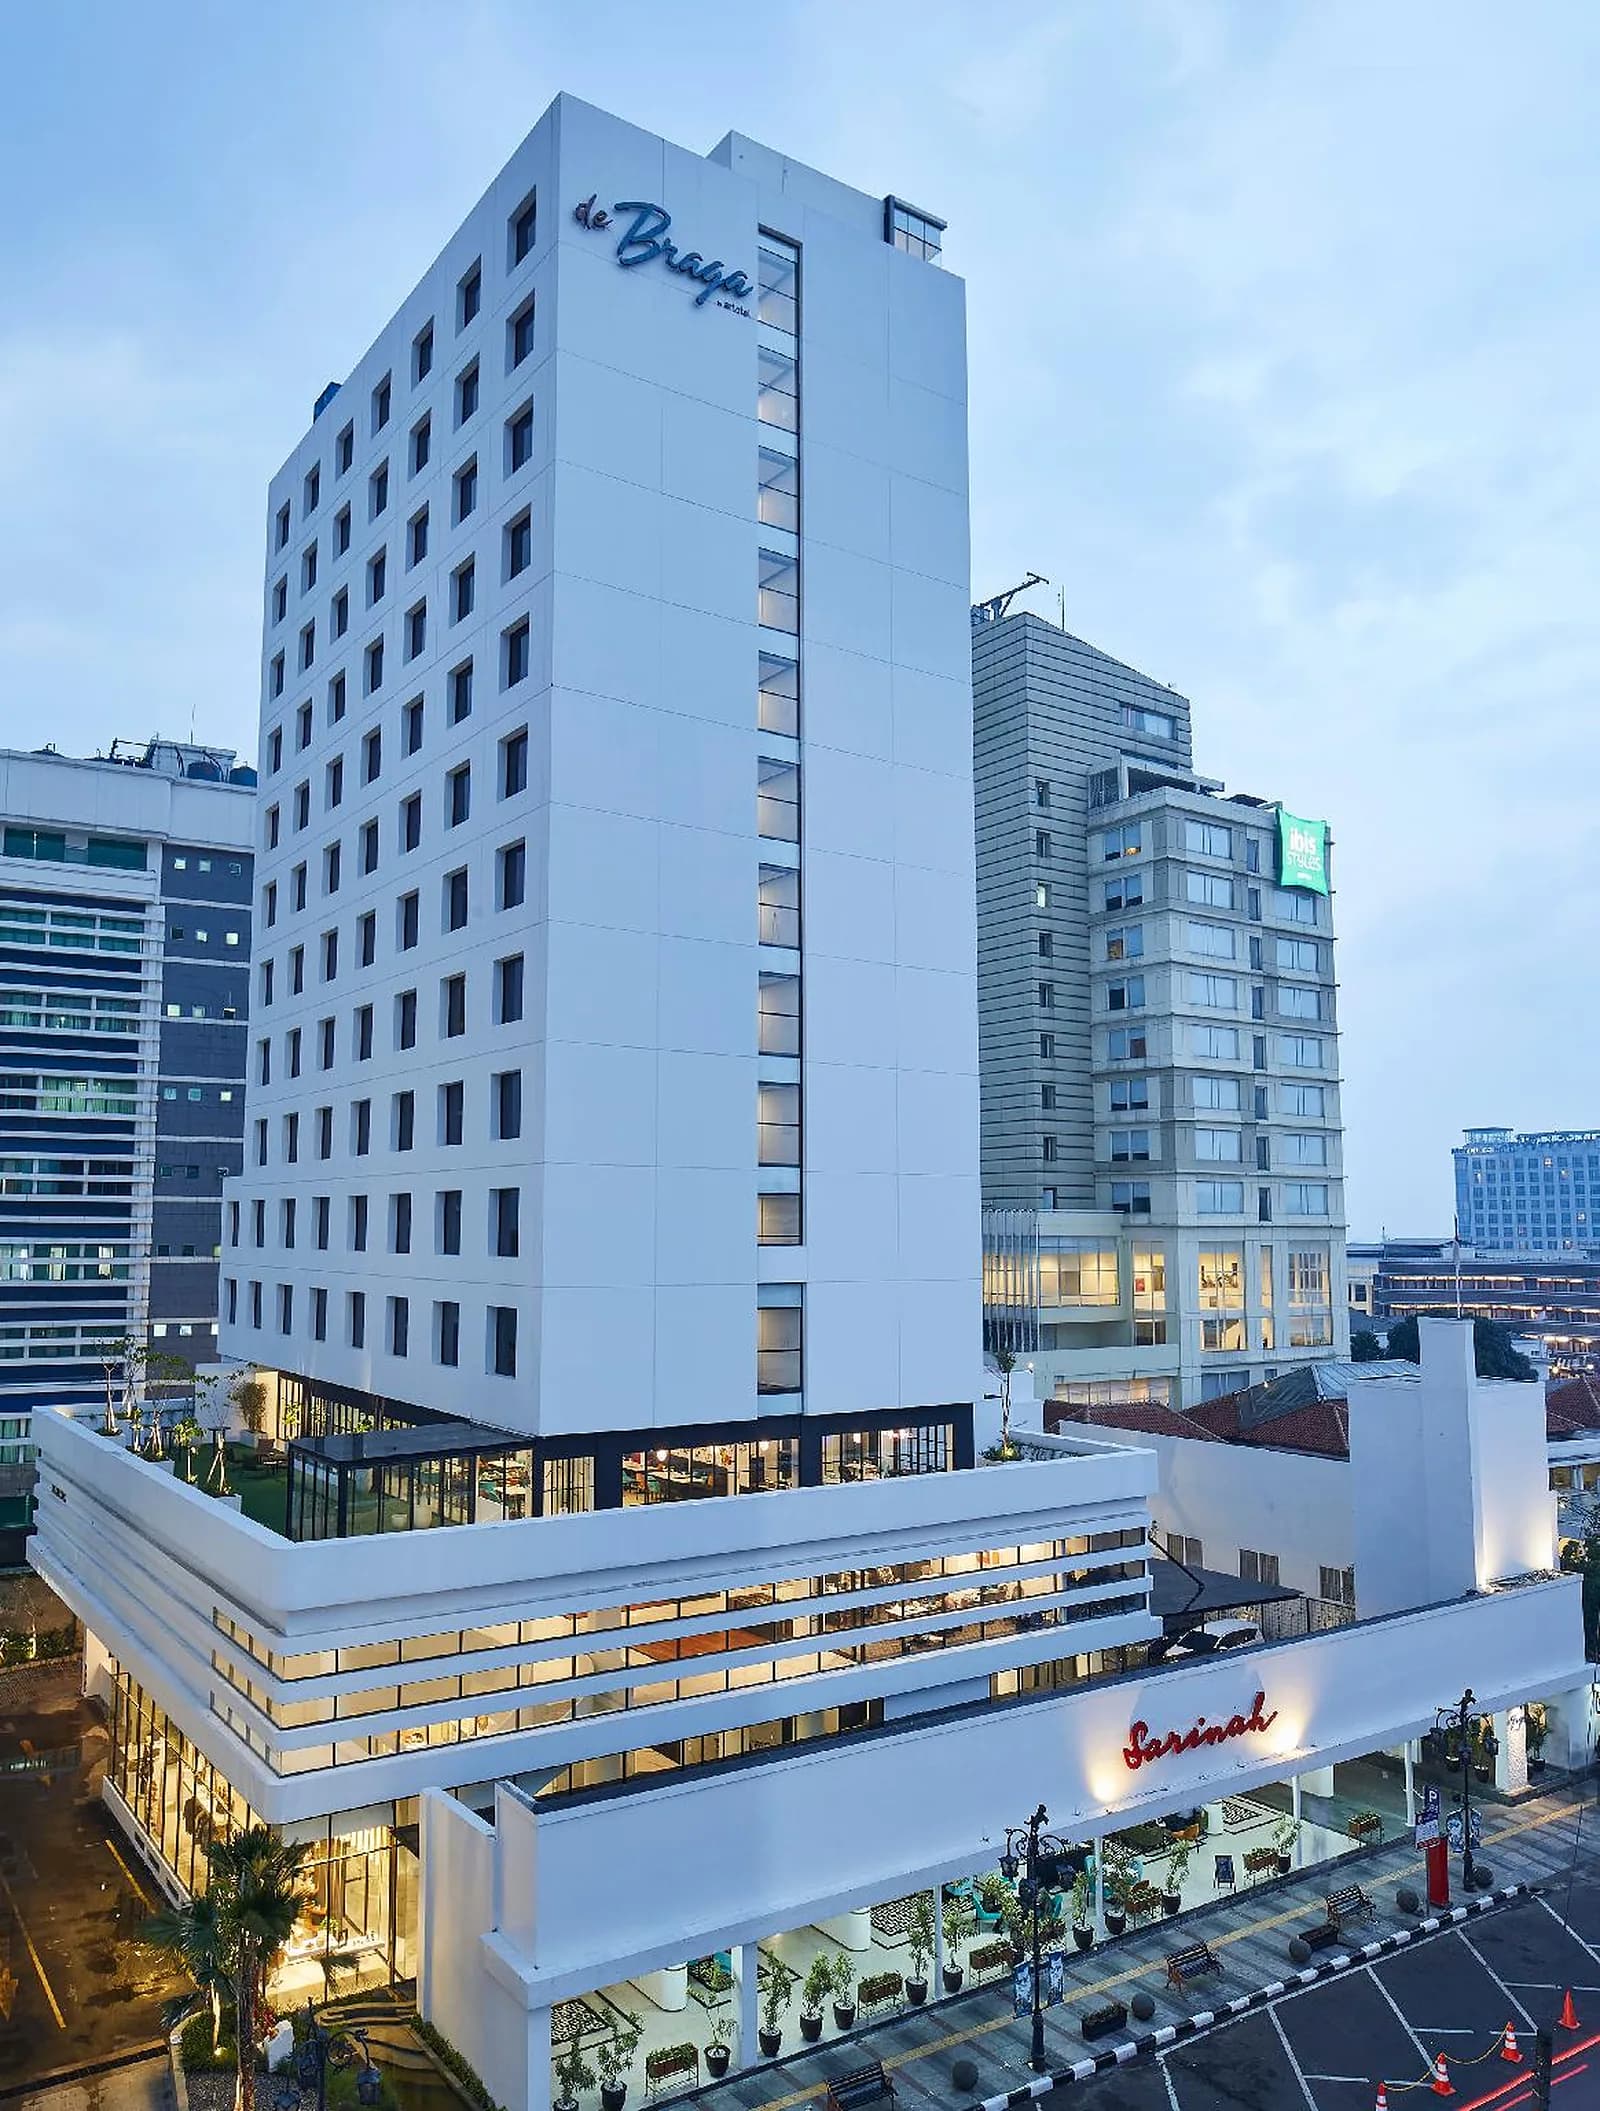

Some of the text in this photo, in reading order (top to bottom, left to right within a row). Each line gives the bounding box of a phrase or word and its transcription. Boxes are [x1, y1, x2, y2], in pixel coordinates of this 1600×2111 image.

[574, 194, 754, 306] de Braga
[1290, 827, 1317, 855] ibis
[1123, 1691, 1278, 1770] Sarinah
[1429, 1790, 1438, 1803] P
